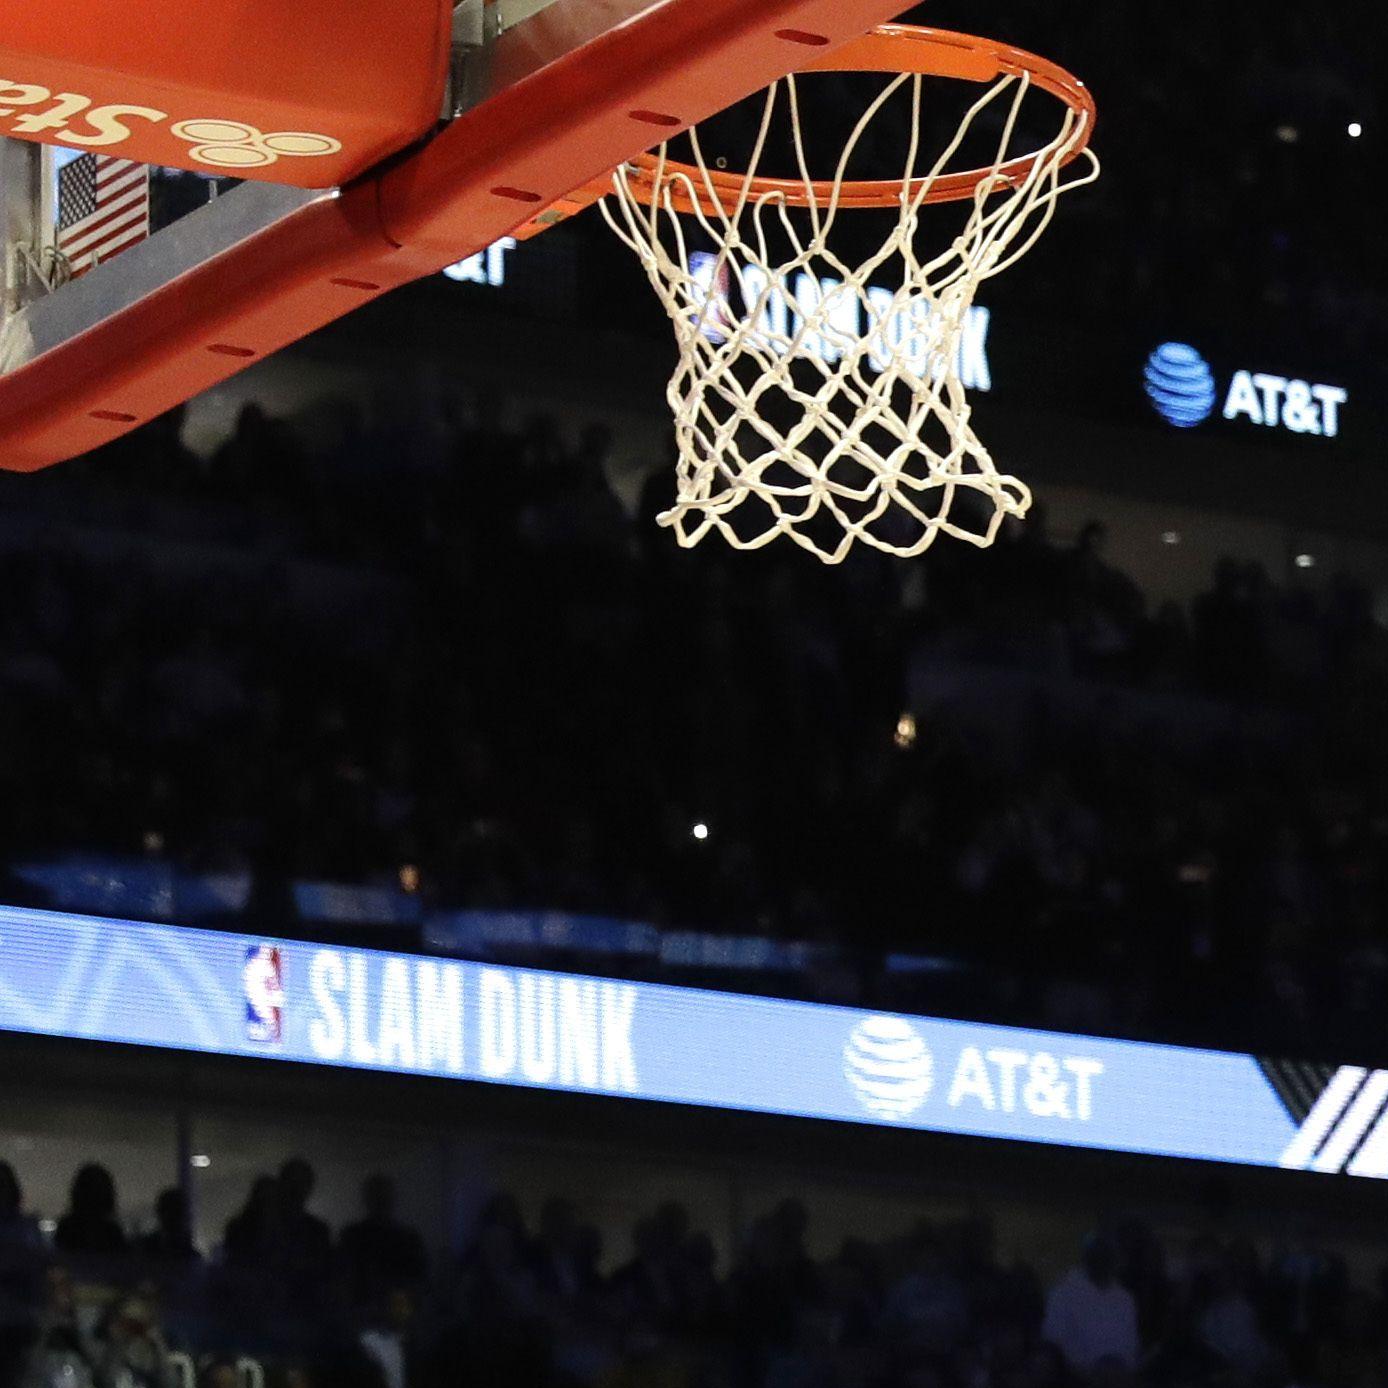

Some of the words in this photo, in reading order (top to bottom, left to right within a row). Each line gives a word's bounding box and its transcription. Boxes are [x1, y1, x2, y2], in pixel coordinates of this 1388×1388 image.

[1224, 369, 1347, 437] AT&T
[309, 948, 465, 1074] SLAM
[479, 967, 639, 1094] DUNK
[946, 1046, 1104, 1121] AT&T
